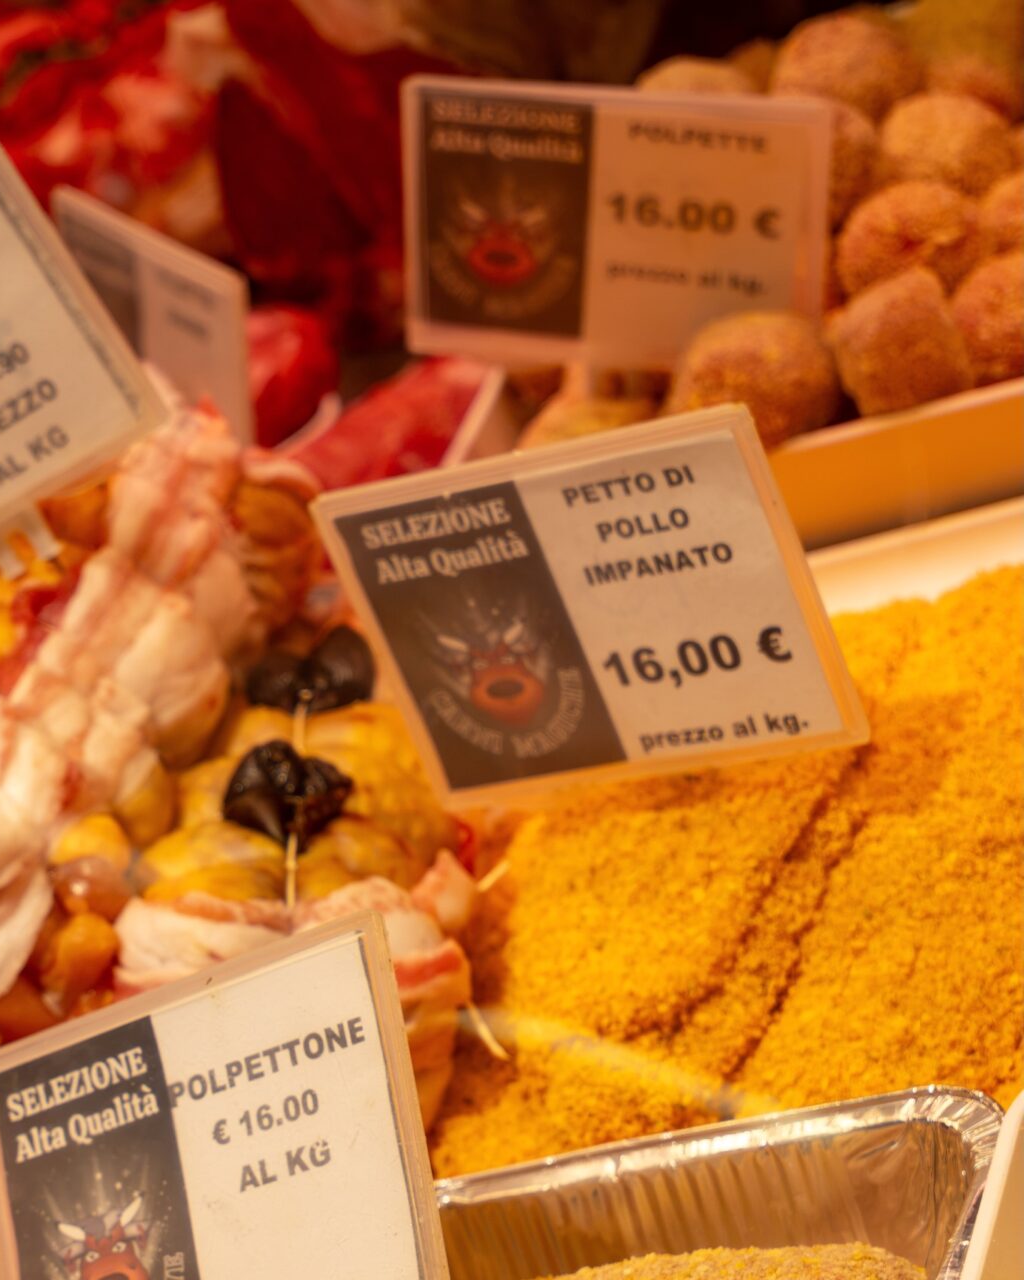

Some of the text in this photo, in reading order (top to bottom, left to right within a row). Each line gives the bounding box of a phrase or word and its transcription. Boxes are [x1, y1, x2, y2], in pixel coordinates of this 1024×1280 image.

[627, 122, 768, 155] POLPETTE
[607, 193, 784, 240] 16.00 €
[28, 425, 70, 462] KG
[562, 465, 695, 508] PETTO DI
[361, 498, 511, 549] SELEZIONE
[596, 508, 690, 543] POLLO
[377, 529, 528, 585] Alta Qualità
[583, 542, 733, 587] IMPANATO
[603, 626, 792, 688] 16,00 €
[640, 711, 810, 755] prezzo al kg.
[6, 1047, 148, 1122] SELEZIONE
[169, 1017, 366, 1109] POLPETTONE
[16, 1084, 160, 1164] Alta Qualità
[212, 1088, 321, 1146] € 16.00
[239, 1138, 332, 1193] AL KG
